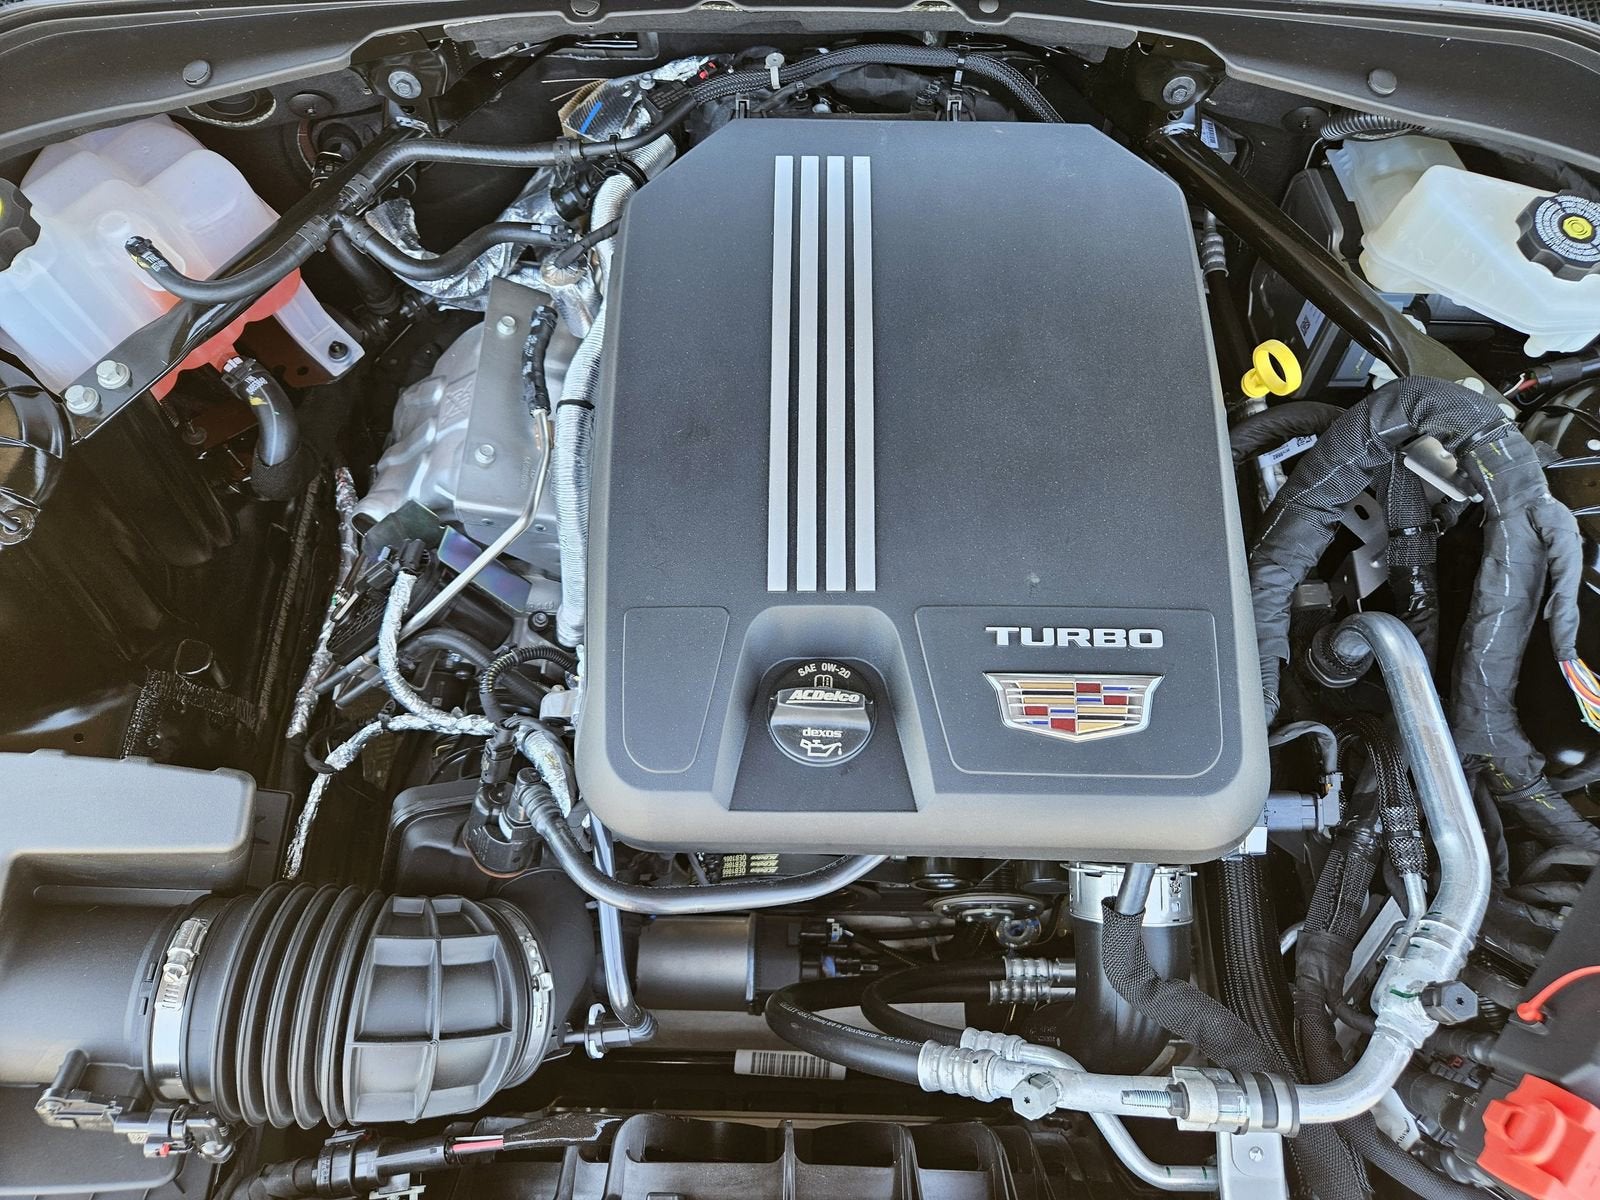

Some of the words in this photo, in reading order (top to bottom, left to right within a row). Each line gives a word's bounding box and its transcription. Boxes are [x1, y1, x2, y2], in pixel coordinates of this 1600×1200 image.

[985, 626, 1164, 649] TURBO
[797, 663, 817, 677] SAE
[821, 662, 851, 679] 0W-20
[786, 689, 860, 703] ACDelco
[802, 727, 843, 738] dexos
